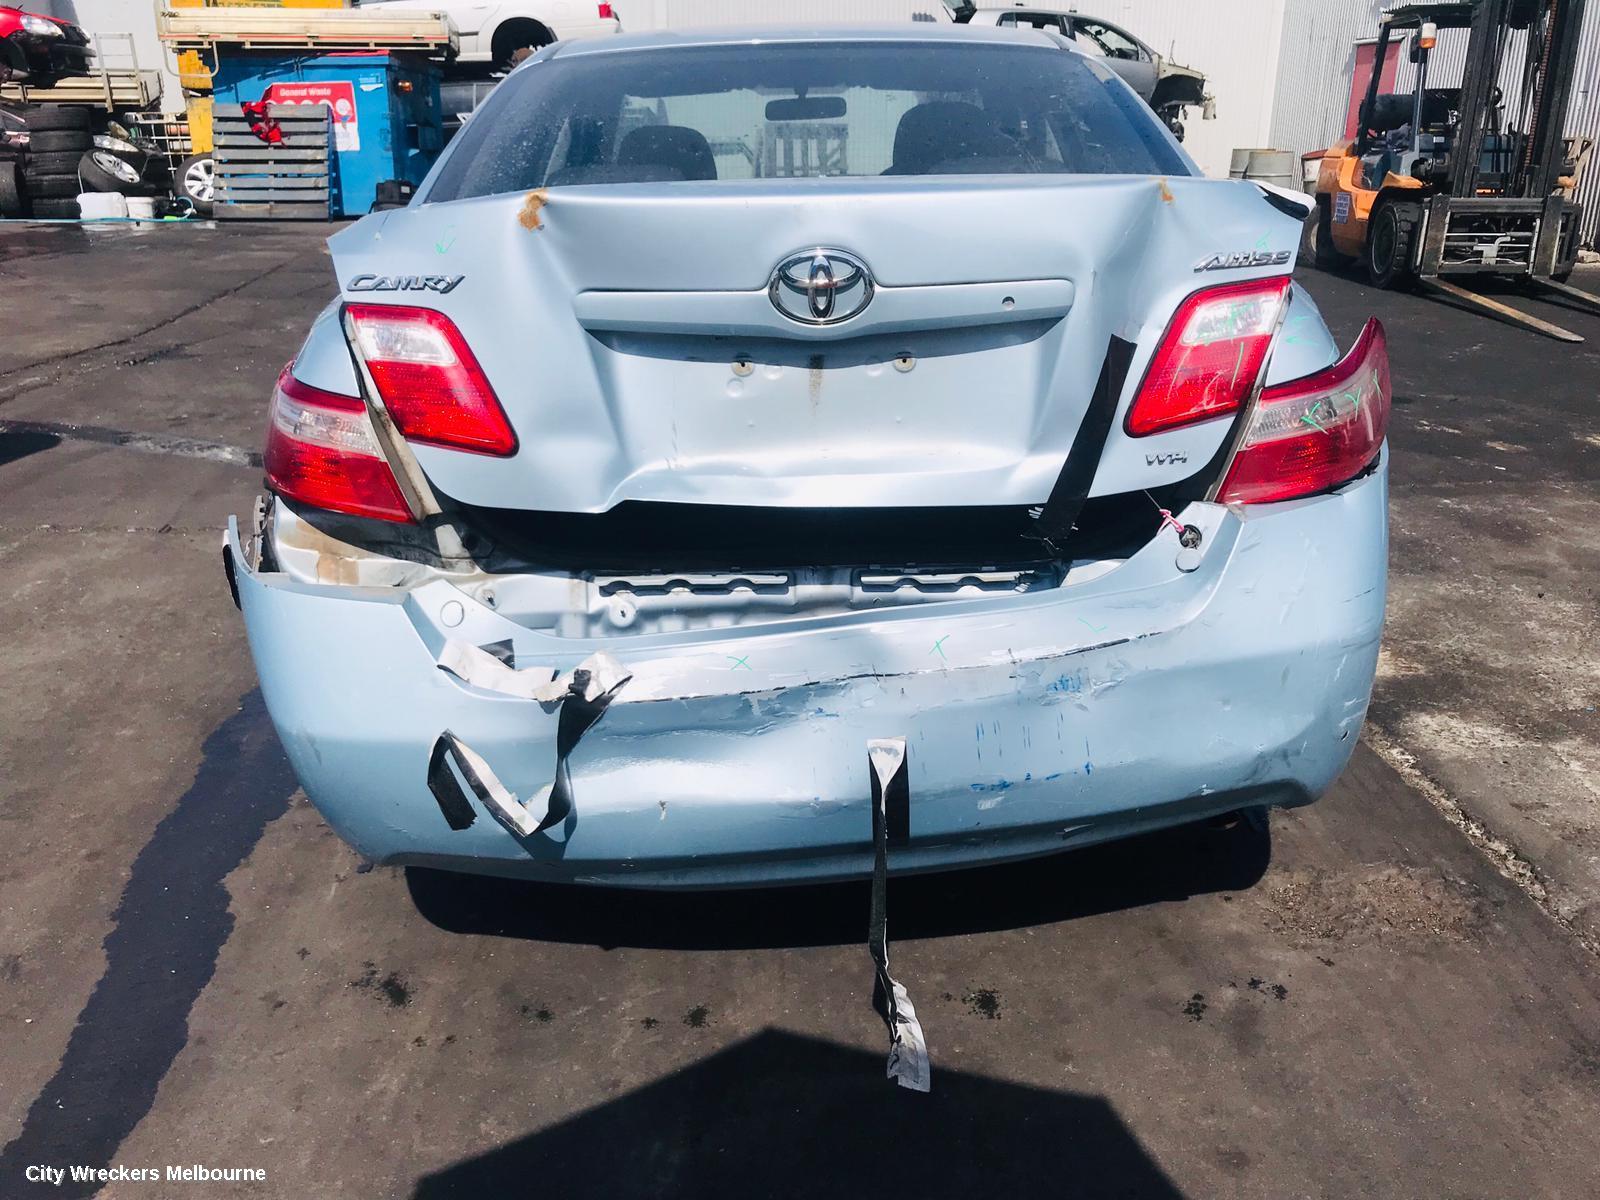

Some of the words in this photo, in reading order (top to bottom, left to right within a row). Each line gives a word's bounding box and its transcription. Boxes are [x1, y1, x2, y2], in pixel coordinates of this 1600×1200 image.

[280, 88, 307, 96] General
[308, 87, 332, 96] Waste
[346, 273, 466, 294] CAMRY
